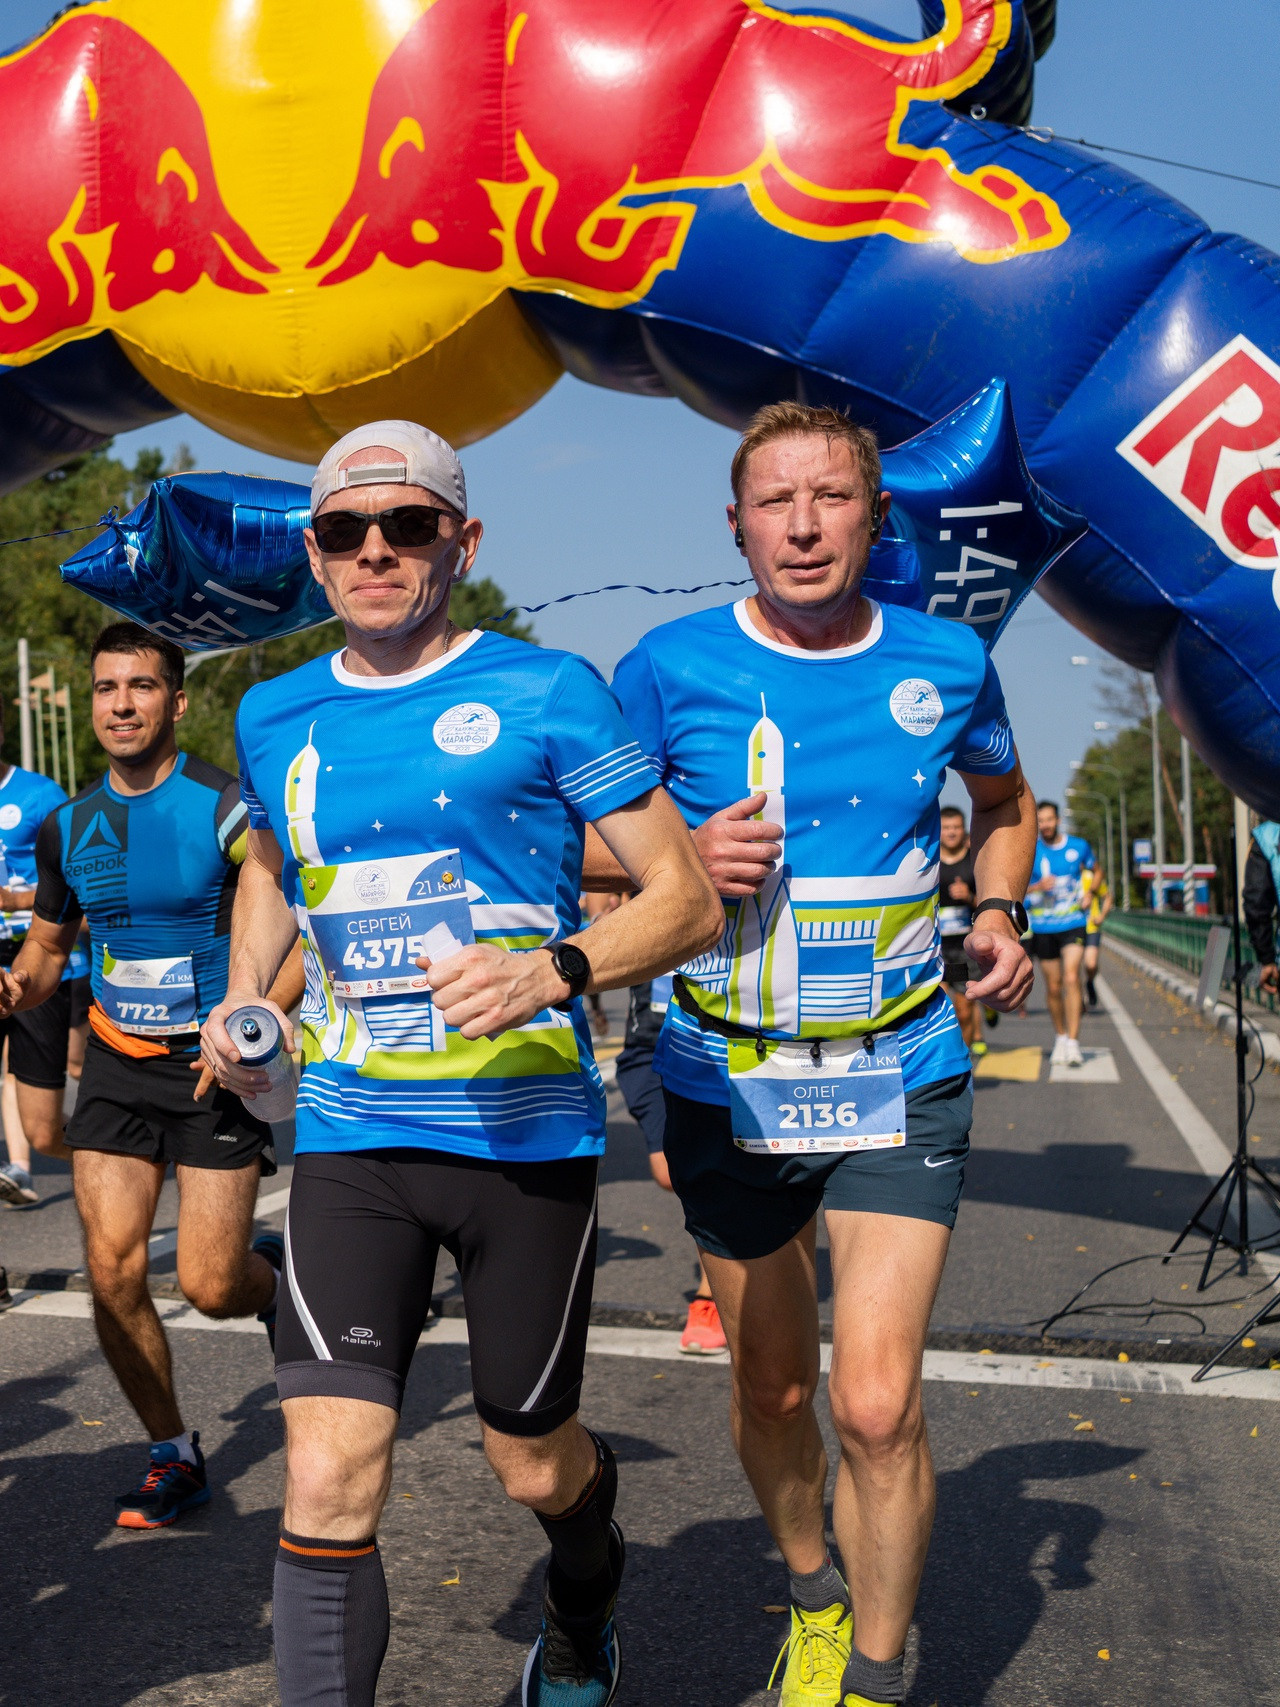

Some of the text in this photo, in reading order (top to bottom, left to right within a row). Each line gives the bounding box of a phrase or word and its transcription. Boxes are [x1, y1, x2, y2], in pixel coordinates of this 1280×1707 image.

[65, 855, 128, 878] Reebok
[414, 880, 433, 896] 21
[347, 912, 412, 935] СЕРГЕЙ
[342, 934, 425, 971] 4375
[164, 973, 175, 983] 21
[116, 1001, 170, 1021] 7722
[856, 1056, 872, 1069] 21
[793, 1085, 840, 1099] ОЛЕГ
[777, 1101, 859, 1129] 2136
[341, 1335, 381, 1348] Kalenji
